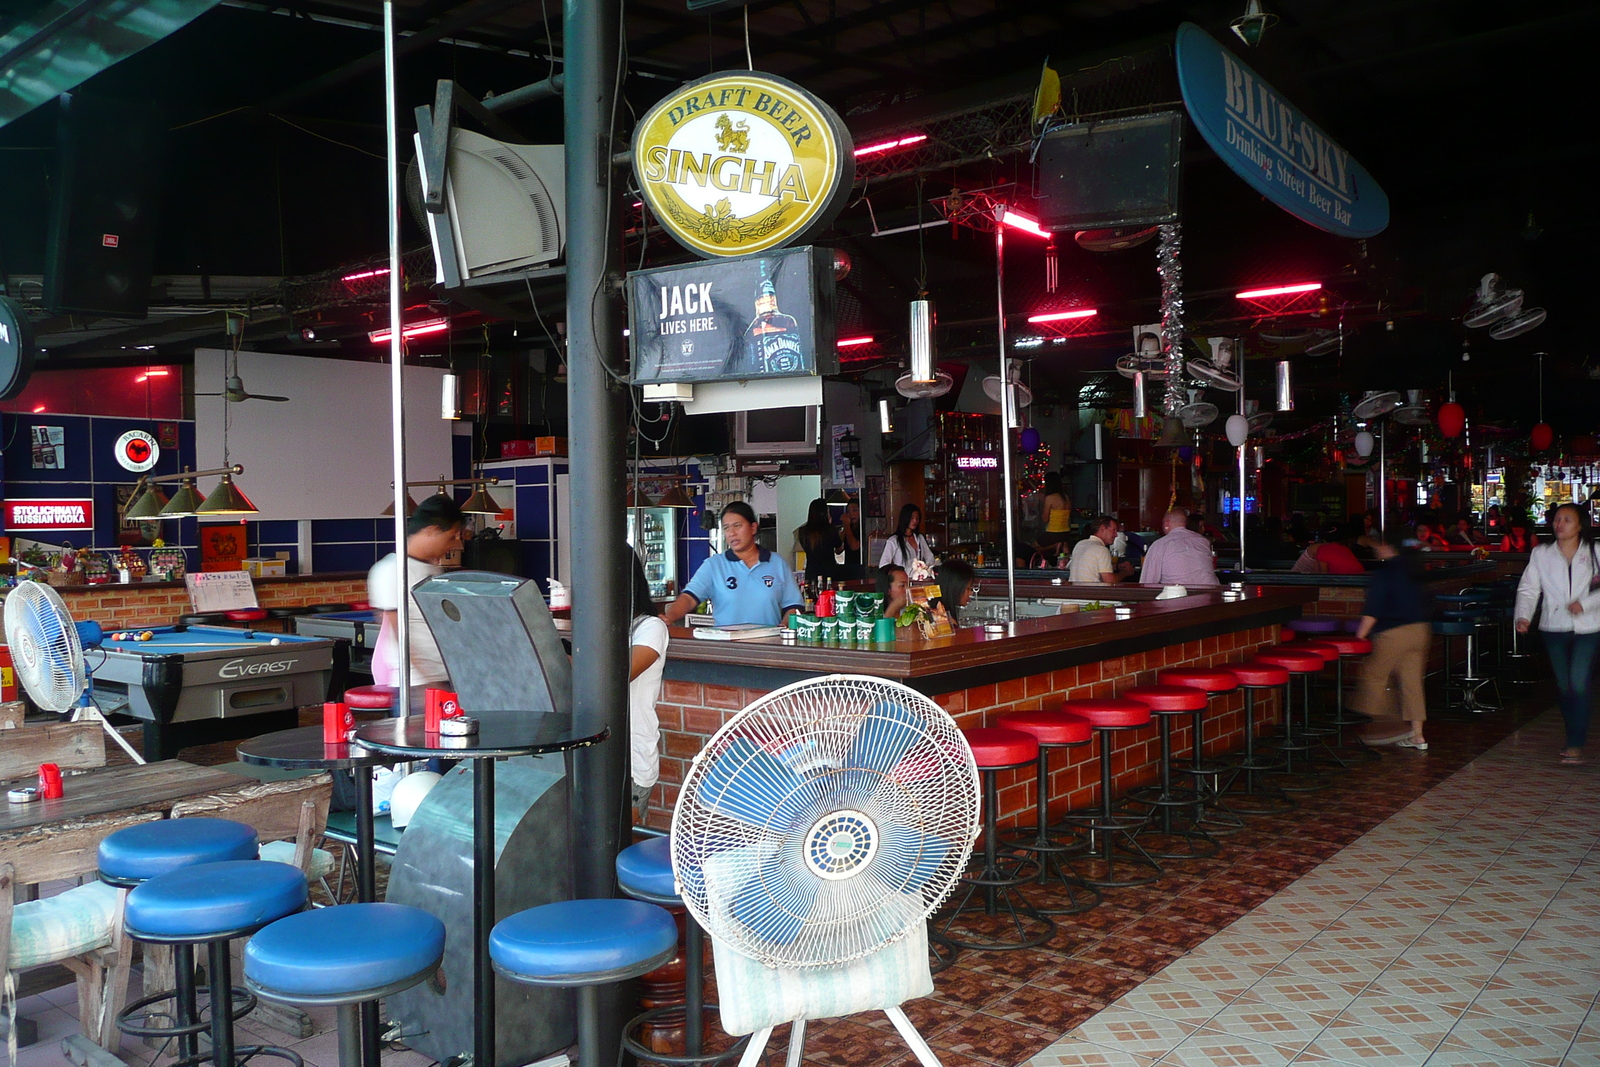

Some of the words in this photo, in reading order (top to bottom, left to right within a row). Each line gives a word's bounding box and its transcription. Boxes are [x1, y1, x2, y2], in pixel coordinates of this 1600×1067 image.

[667, 88, 751, 126] DRAFT
[752, 92, 814, 148] BEER
[1221, 51, 1349, 195] BLUE-SKY
[646, 146, 811, 204] SINGHA
[1226, 118, 1273, 182] Drinking
[1277, 158, 1306, 199] Street
[1309, 183, 1332, 215] Beer
[1334, 200, 1352, 227] Bar
[659, 281, 715, 320] JACK
[660, 318, 687, 336] LIVES
[689, 316, 718, 333] HERE.
[13, 505, 84, 515] STOLICHNAYA
[14, 514, 54, 524] RUSSIAN
[55, 514, 85, 523] VODKA
[726, 576, 738, 590] 3
[218, 658, 299, 679] EVEREST
